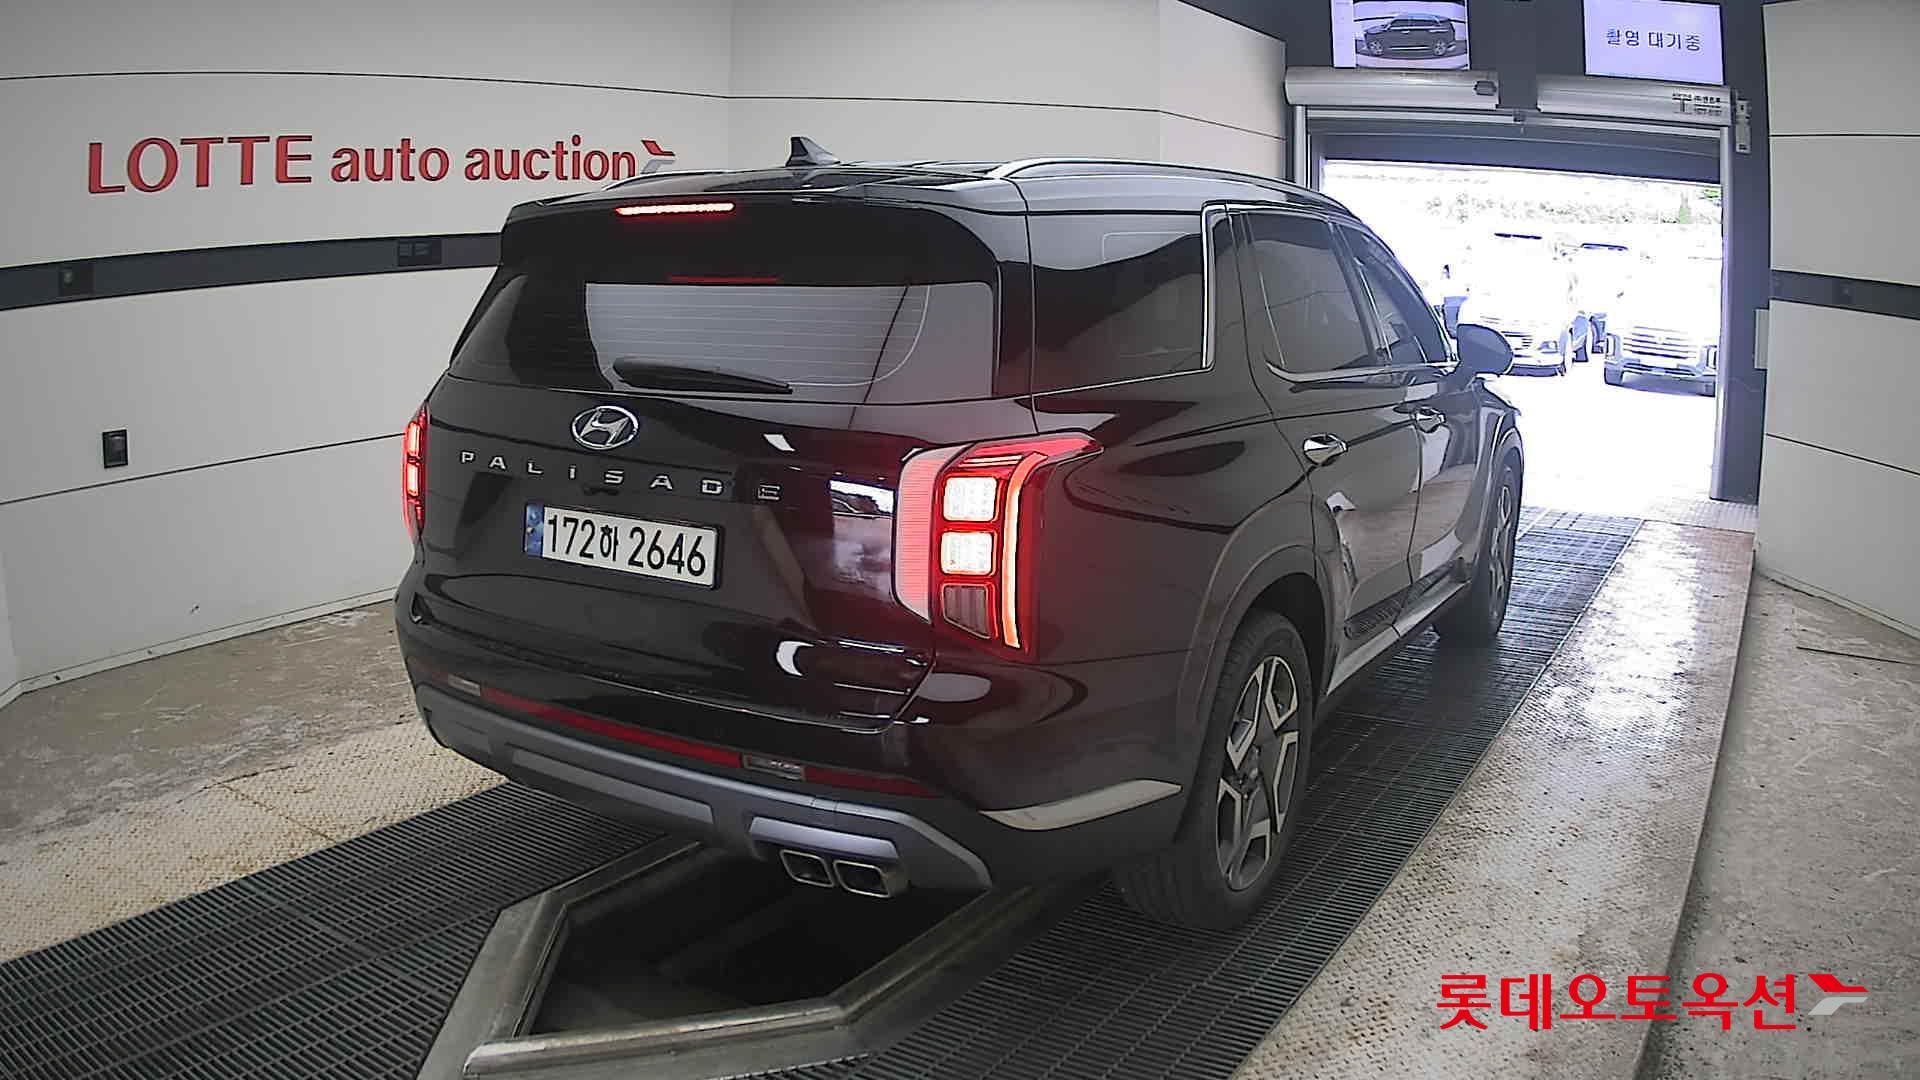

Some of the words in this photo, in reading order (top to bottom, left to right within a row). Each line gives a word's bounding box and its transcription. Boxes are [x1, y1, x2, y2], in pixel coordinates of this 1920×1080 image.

[1607, 28, 1640, 47] 촬영
[88, 135, 312, 194] LOTTE
[331, 138, 450, 183] auto
[464, 135, 637, 181] auction
[460, 451, 782, 501] PALISADE
[548, 514, 620, 562] 172하
[627, 526, 707, 578] 2646
